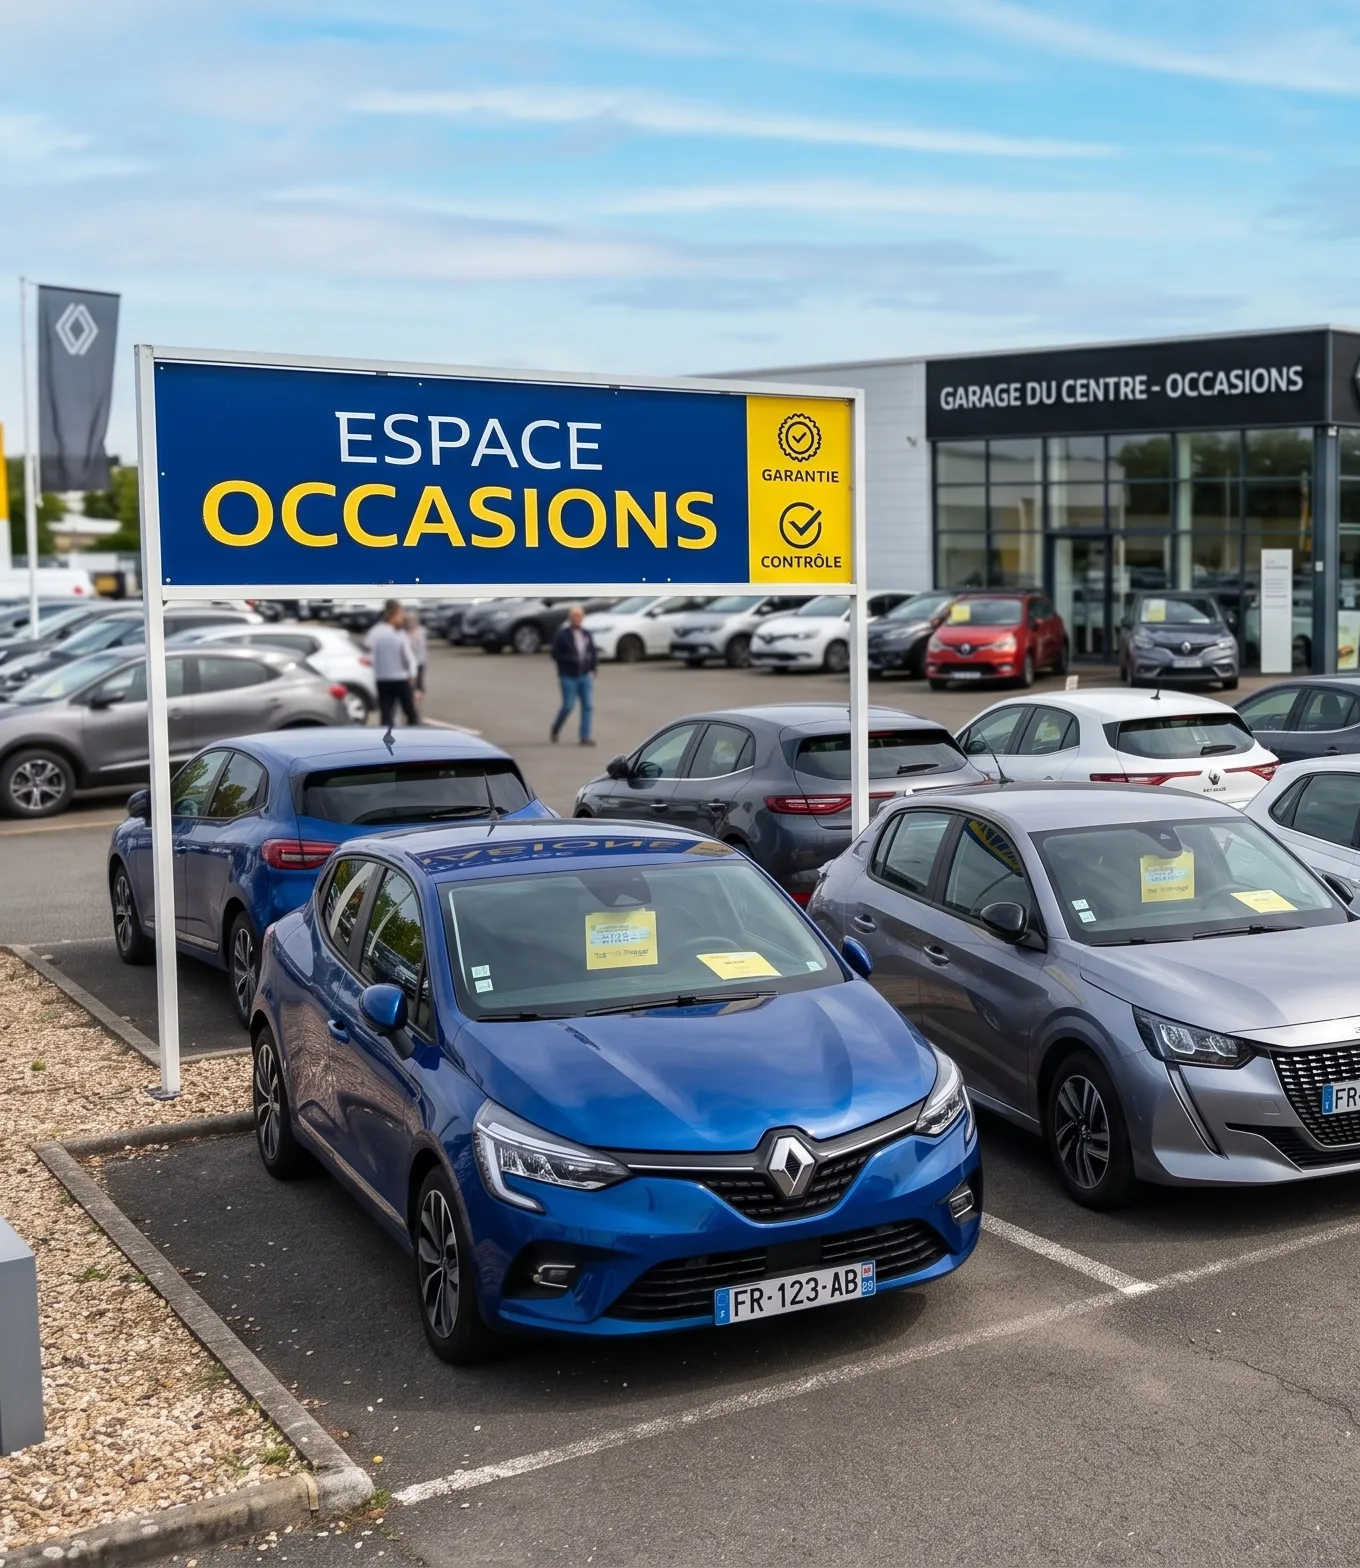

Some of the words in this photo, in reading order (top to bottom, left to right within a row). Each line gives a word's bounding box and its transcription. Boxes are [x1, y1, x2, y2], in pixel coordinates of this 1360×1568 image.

[940, 383, 1021, 410] GARAGE
[1026, 380, 1057, 405] DU
[1061, 375, 1148, 403] CENTRE
[1165, 365, 1303, 398] OCCASIONS
[334, 411, 603, 471] ESPACE
[761, 468, 840, 483] GARANTIE
[202, 479, 717, 550] OCCASIONS
[760, 552, 842, 568] CONTRÔLE
[733, 1268, 858, 1317] FR-123-AB
